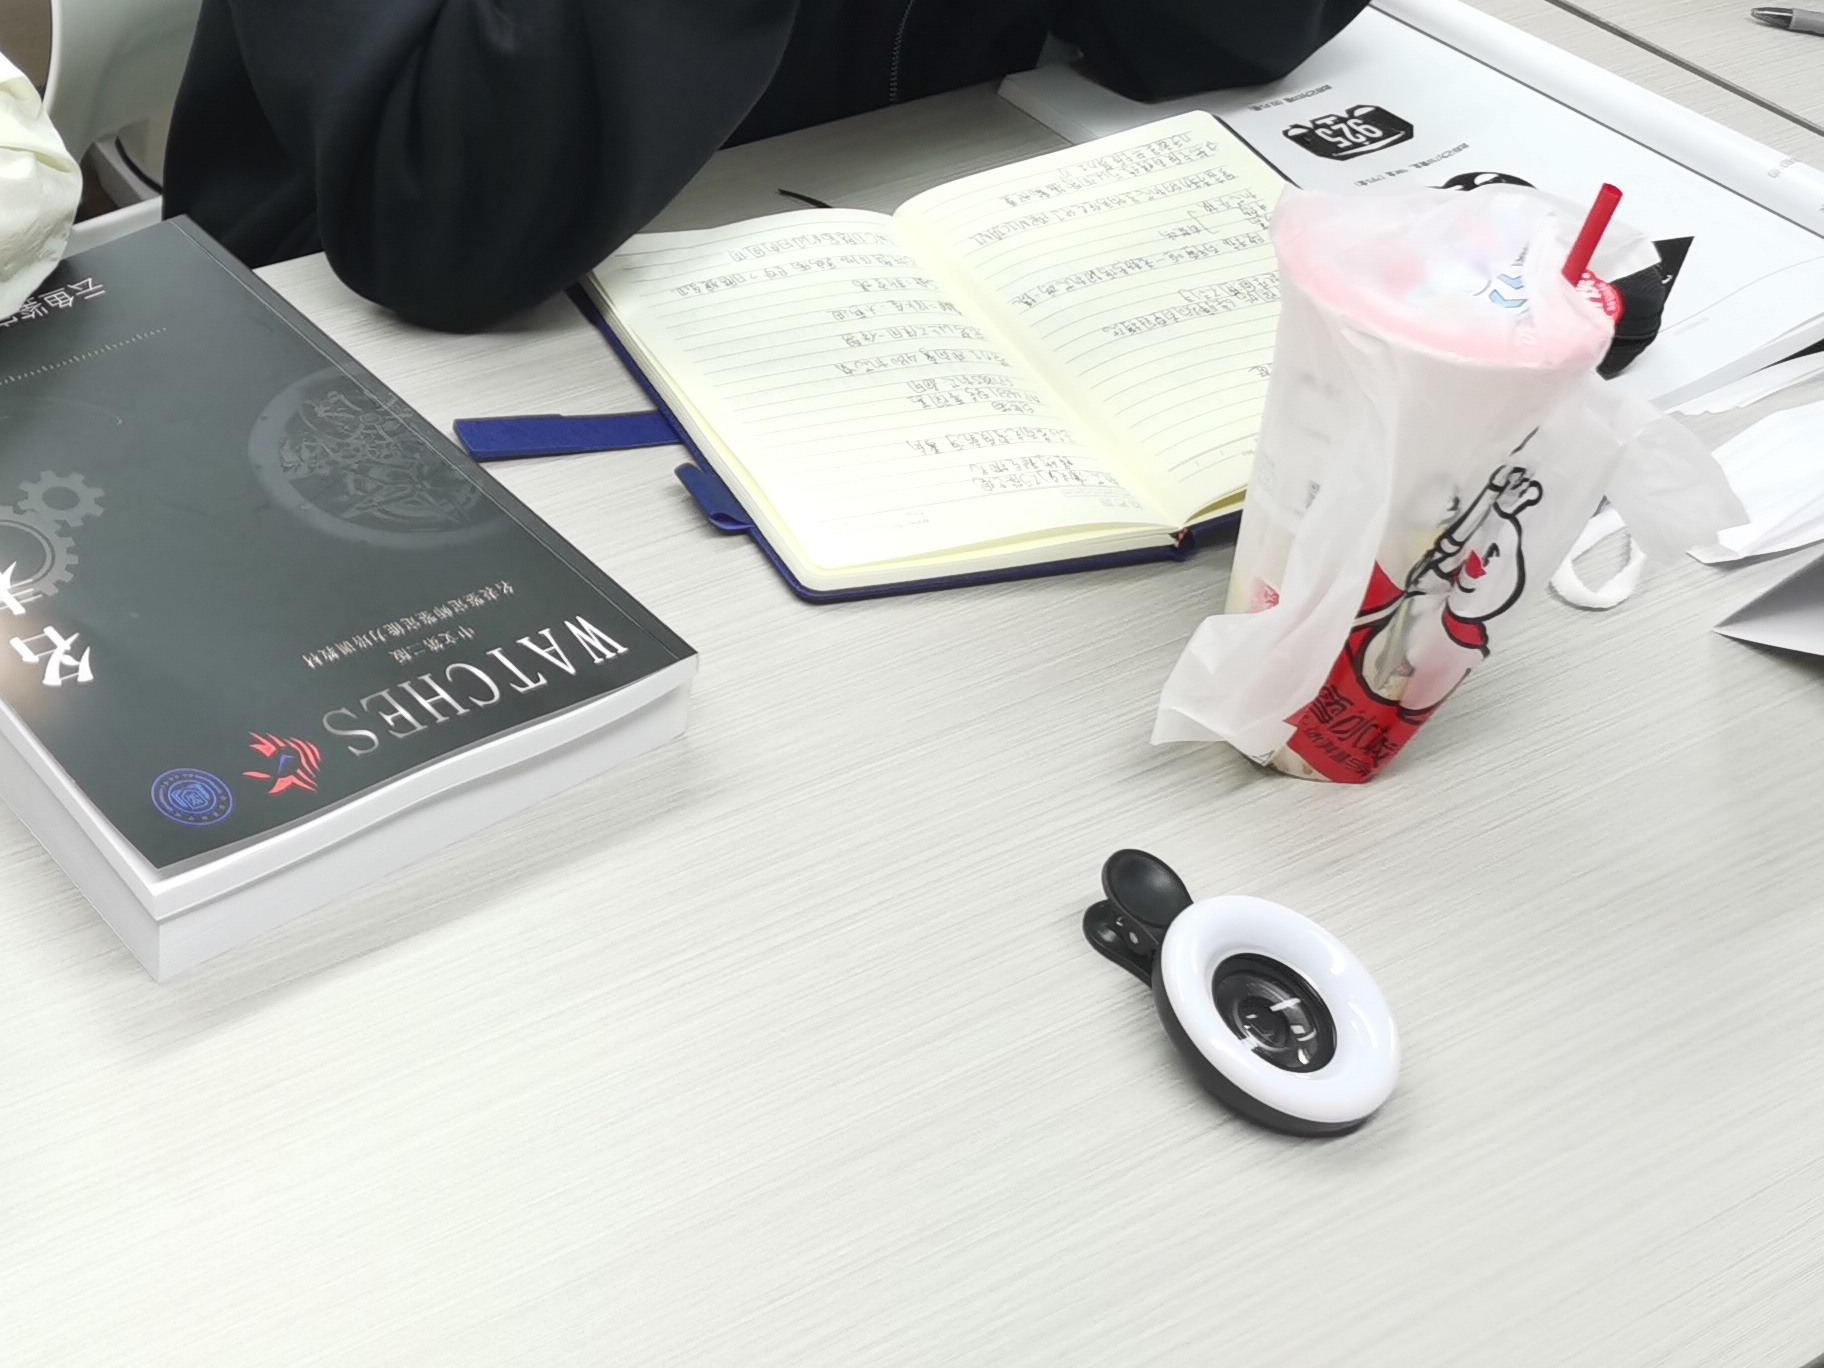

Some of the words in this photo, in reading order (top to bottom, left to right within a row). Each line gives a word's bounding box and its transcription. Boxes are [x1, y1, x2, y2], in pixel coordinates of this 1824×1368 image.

[1315, 118, 1384, 149] 925
[389, 624, 475, 666] 中文第二版
[322, 615, 629, 757] WATCHES
